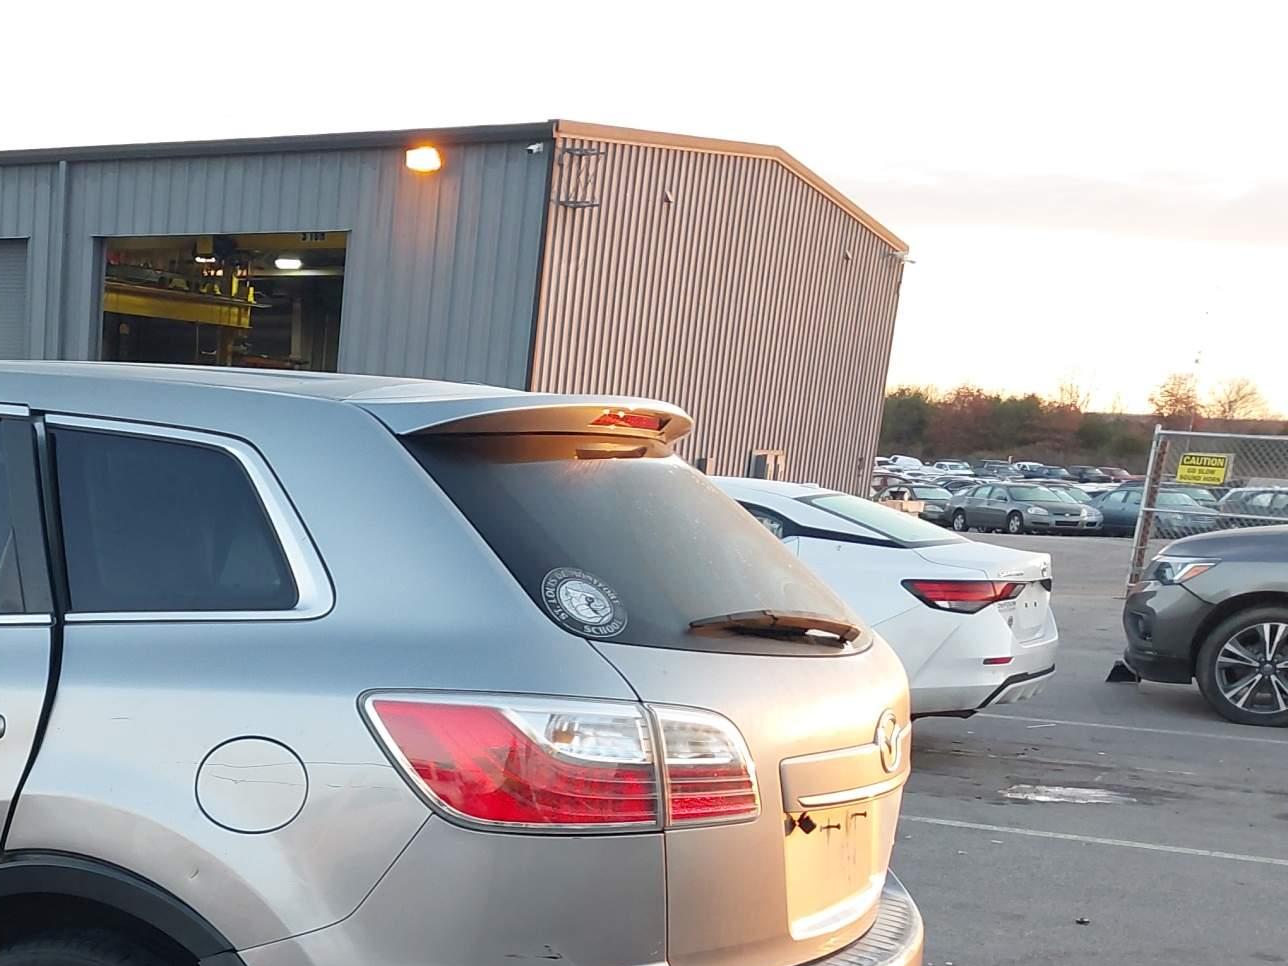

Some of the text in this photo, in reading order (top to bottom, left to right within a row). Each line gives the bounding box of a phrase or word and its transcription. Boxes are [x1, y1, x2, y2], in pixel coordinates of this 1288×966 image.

[1183, 456, 1225, 467] CAUTION
[544, 577, 558, 604] LOUIS
[584, 619, 623, 634] SCHOOL
